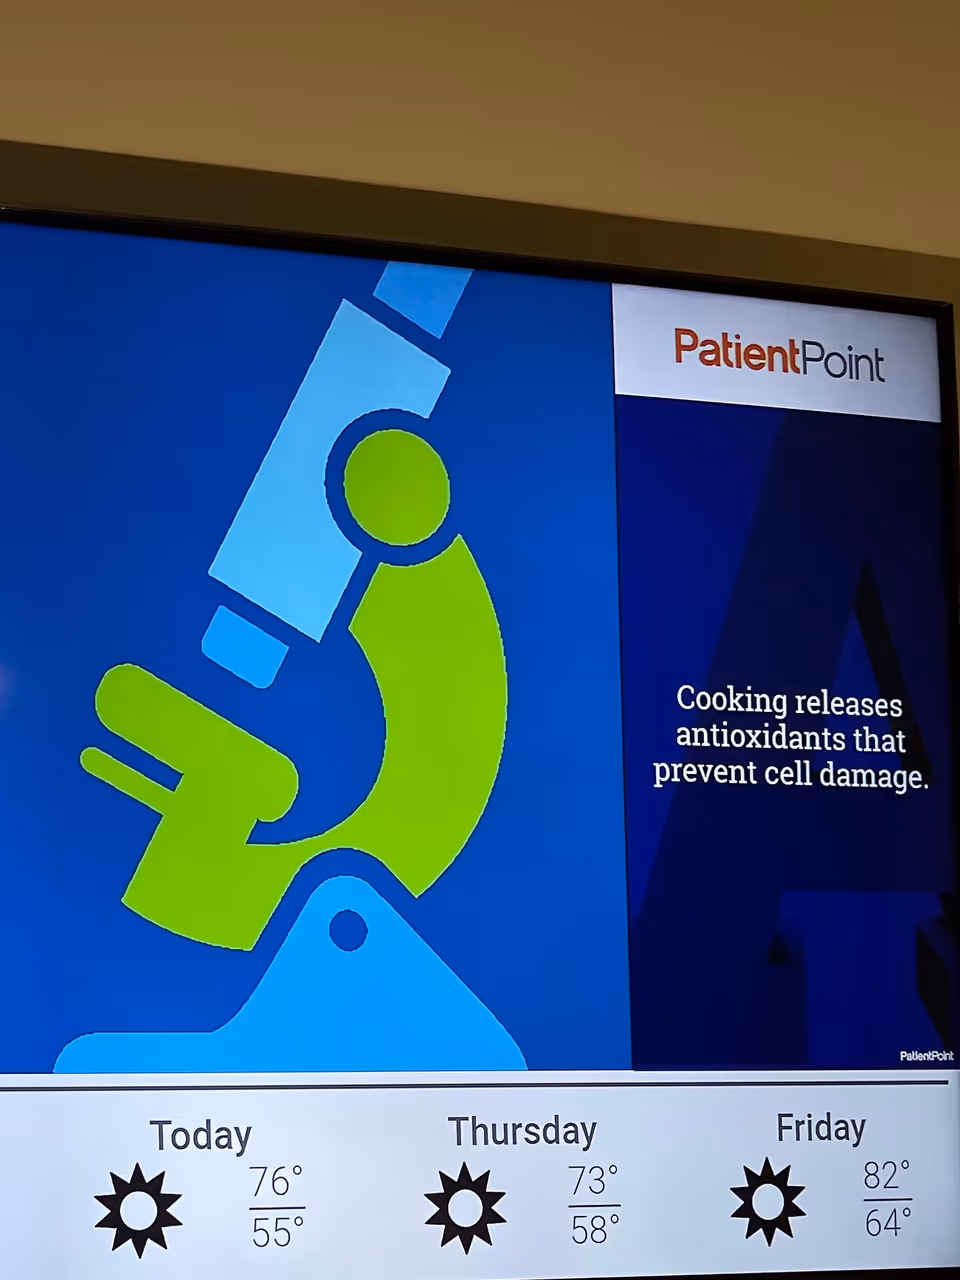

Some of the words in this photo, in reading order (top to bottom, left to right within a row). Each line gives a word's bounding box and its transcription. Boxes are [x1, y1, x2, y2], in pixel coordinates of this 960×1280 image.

[674, 328, 885, 382] PatientPoint
[677, 684, 787, 719] Cooking
[795, 689, 902, 717] releases
[677, 721, 846, 751] antioxidants
[853, 726, 906, 752] that
[653, 761, 757, 787] prevent
[765, 760, 812, 785] cell
[820, 760, 928, 794] damage.
[900, 1050, 954, 1061] PatientPoint
[149, 1119, 252, 1158] Today
[447, 1115, 597, 1151] Thursday
[777, 1112, 866, 1149] Friday
